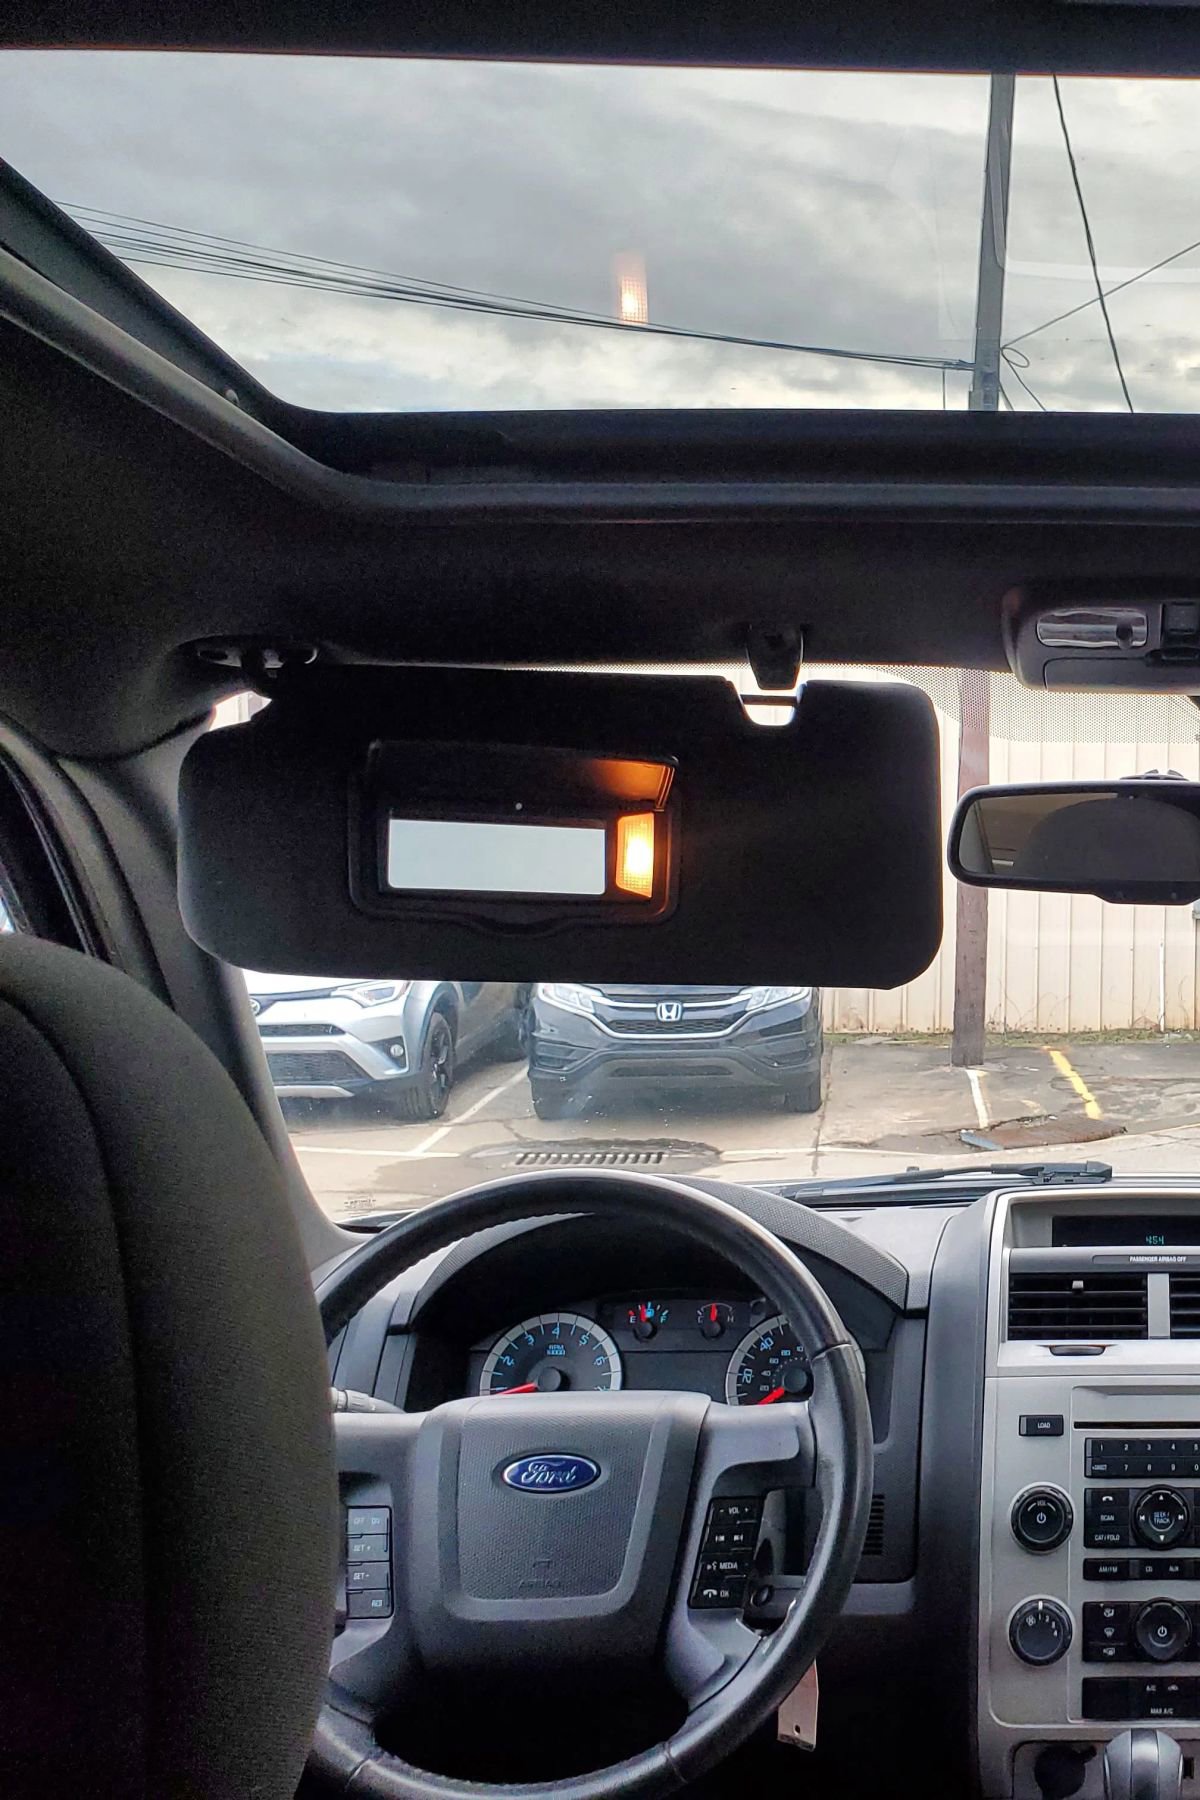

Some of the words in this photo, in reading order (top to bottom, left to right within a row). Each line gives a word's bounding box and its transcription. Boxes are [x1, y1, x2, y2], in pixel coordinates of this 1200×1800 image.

[629, 1315, 636, 1323] E
[660, 1315, 667, 1323] F
[579, 1334, 589, 1345] 5
[760, 1337, 774, 1351] 40
[521, 1460, 577, 1484] Ford
[719, 1562, 738, 1570] MEDIA
